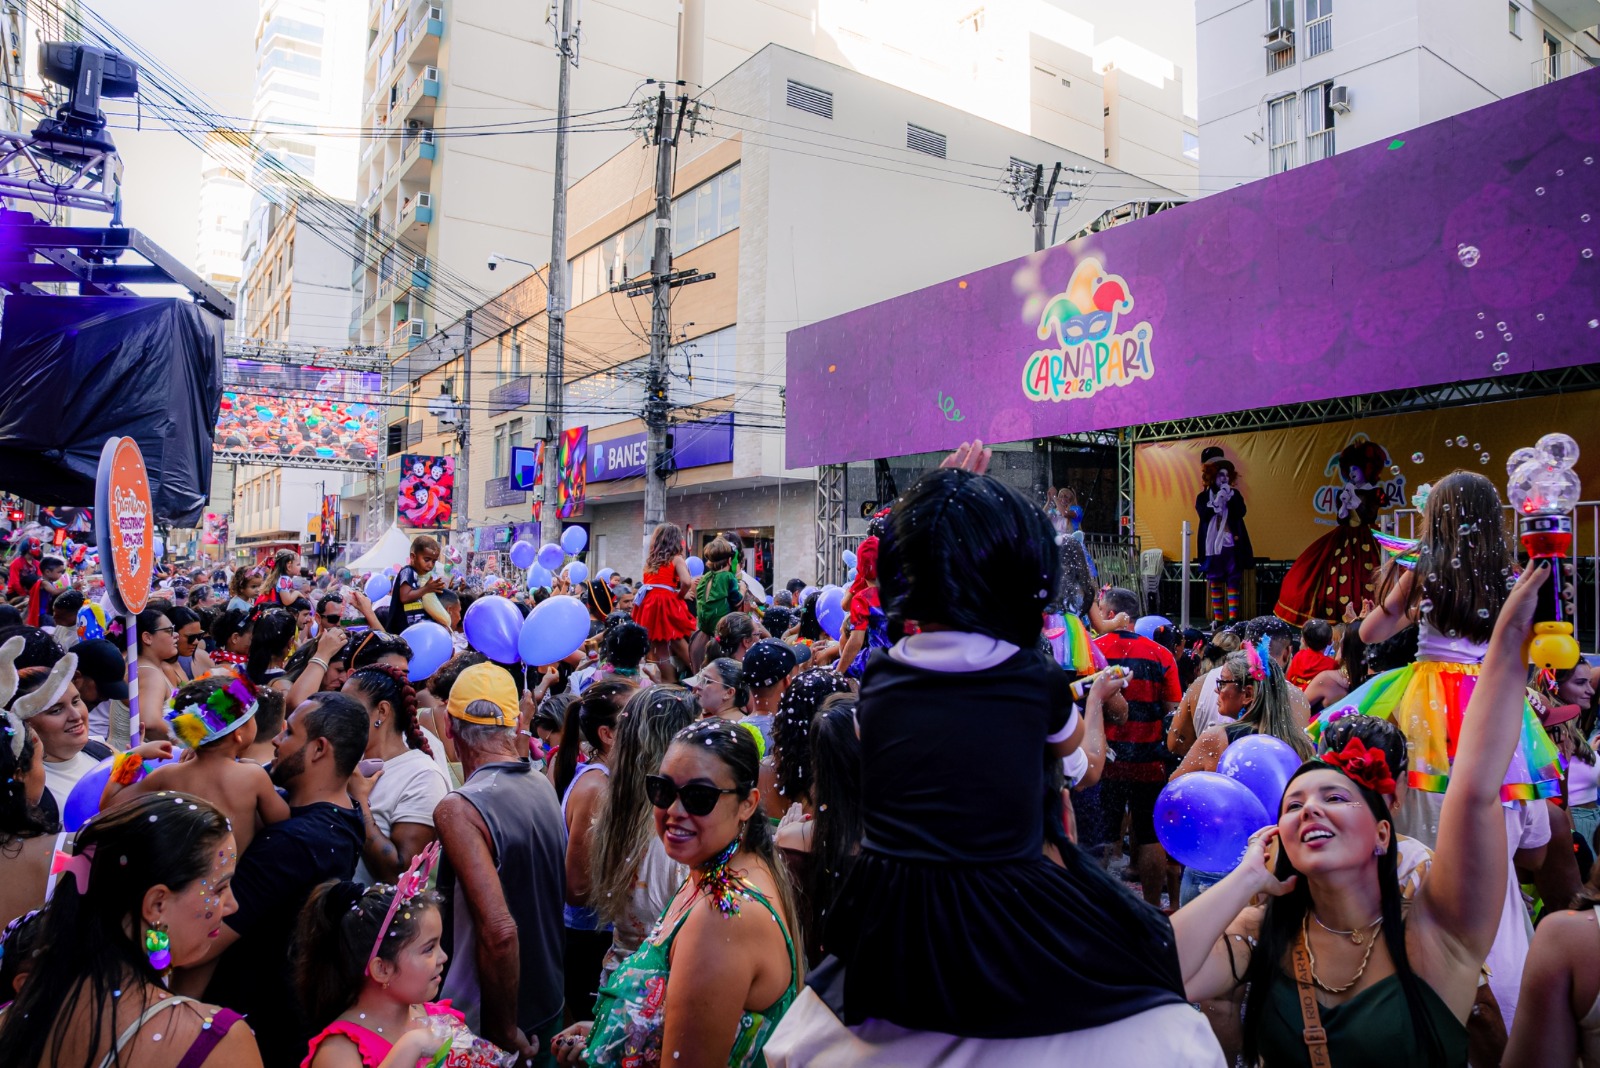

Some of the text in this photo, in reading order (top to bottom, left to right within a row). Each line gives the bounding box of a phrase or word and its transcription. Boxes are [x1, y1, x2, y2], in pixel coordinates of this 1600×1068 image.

[1064, 378, 1093, 394] 2026
[608, 441, 648, 470] BANES
[1296, 951, 1310, 991] FARM
[1304, 996, 1316, 1019] RIO
